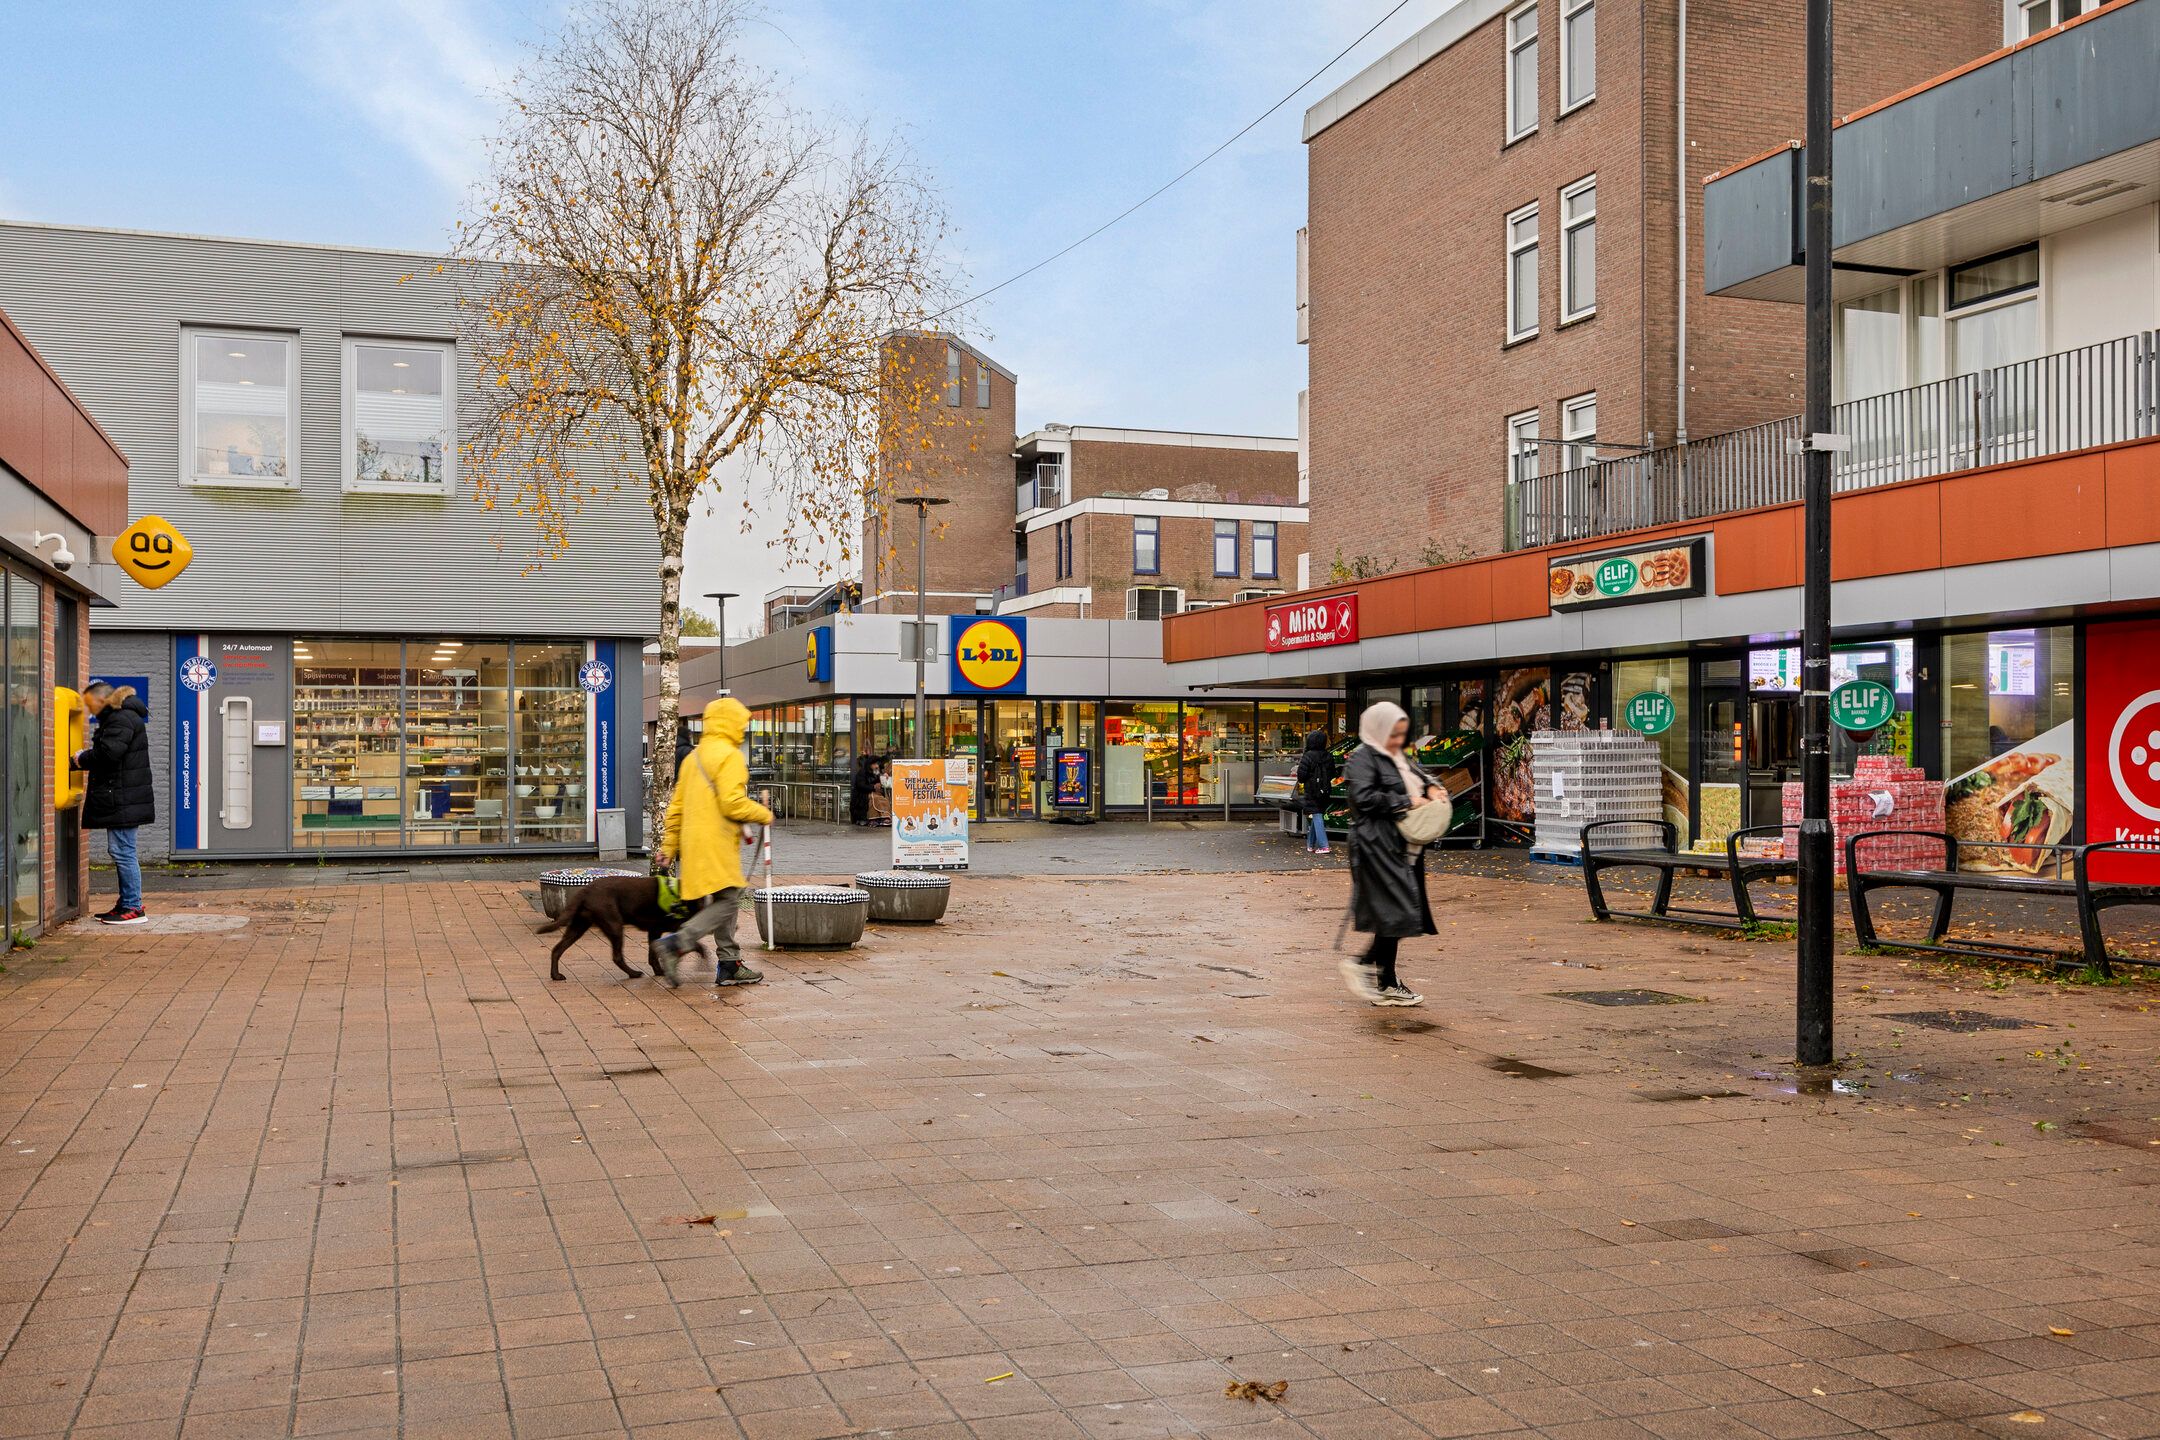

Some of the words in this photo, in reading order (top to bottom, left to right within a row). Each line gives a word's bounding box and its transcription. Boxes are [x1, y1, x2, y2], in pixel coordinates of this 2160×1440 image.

[1603, 563, 1629, 581] ELIF
[1281, 634, 1310, 647] Supermarkt
[1310, 633, 1315, 642] &
[1315, 629, 1336, 642] Slagerij
[183, 658, 214, 670] SERVICE
[582, 661, 608, 674] SERVICE
[181, 675, 216, 691] APOTHEEK
[303, 672, 347, 680] Spijsvertering
[580, 677, 611, 692] APOTHEEK
[1841, 688, 1880, 709] ELIF
[1635, 698, 1665, 716] ELIF
[913, 789, 945, 800] FESTIVAL
